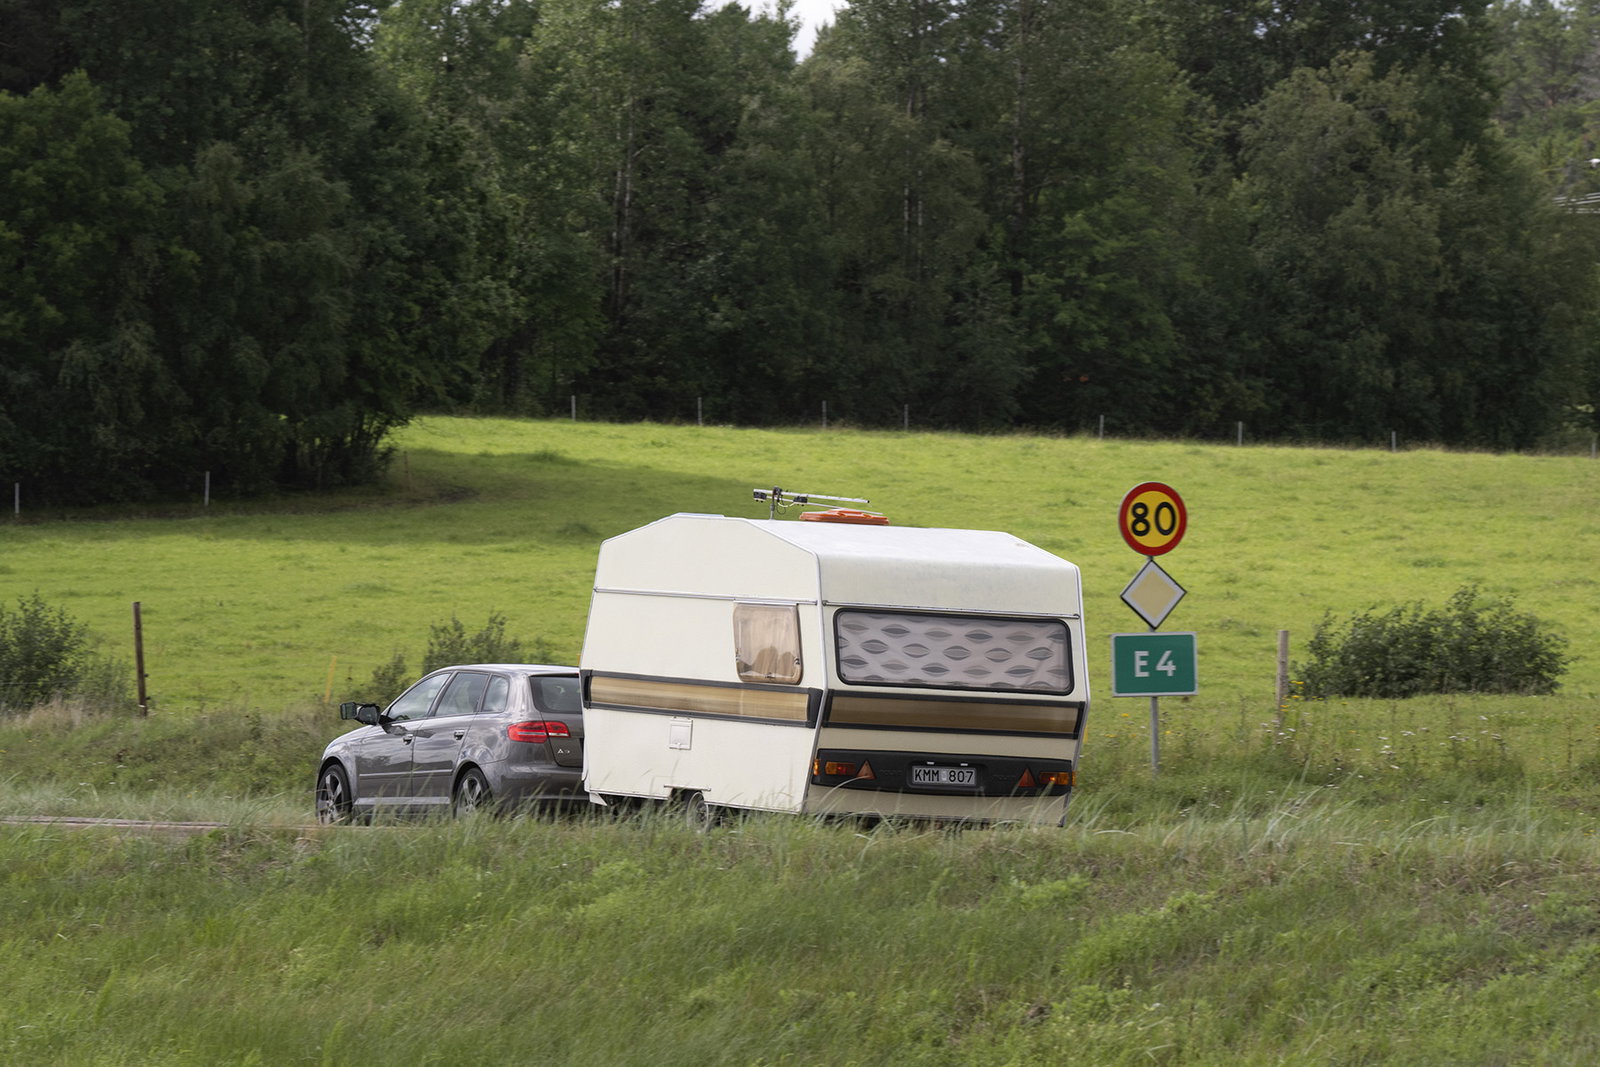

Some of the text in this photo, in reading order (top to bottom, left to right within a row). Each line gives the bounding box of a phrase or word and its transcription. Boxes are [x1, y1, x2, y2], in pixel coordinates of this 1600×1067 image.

[1131, 501, 1176, 537] 80
[914, 769, 940, 782] KMM
[948, 770, 974, 783] 807
